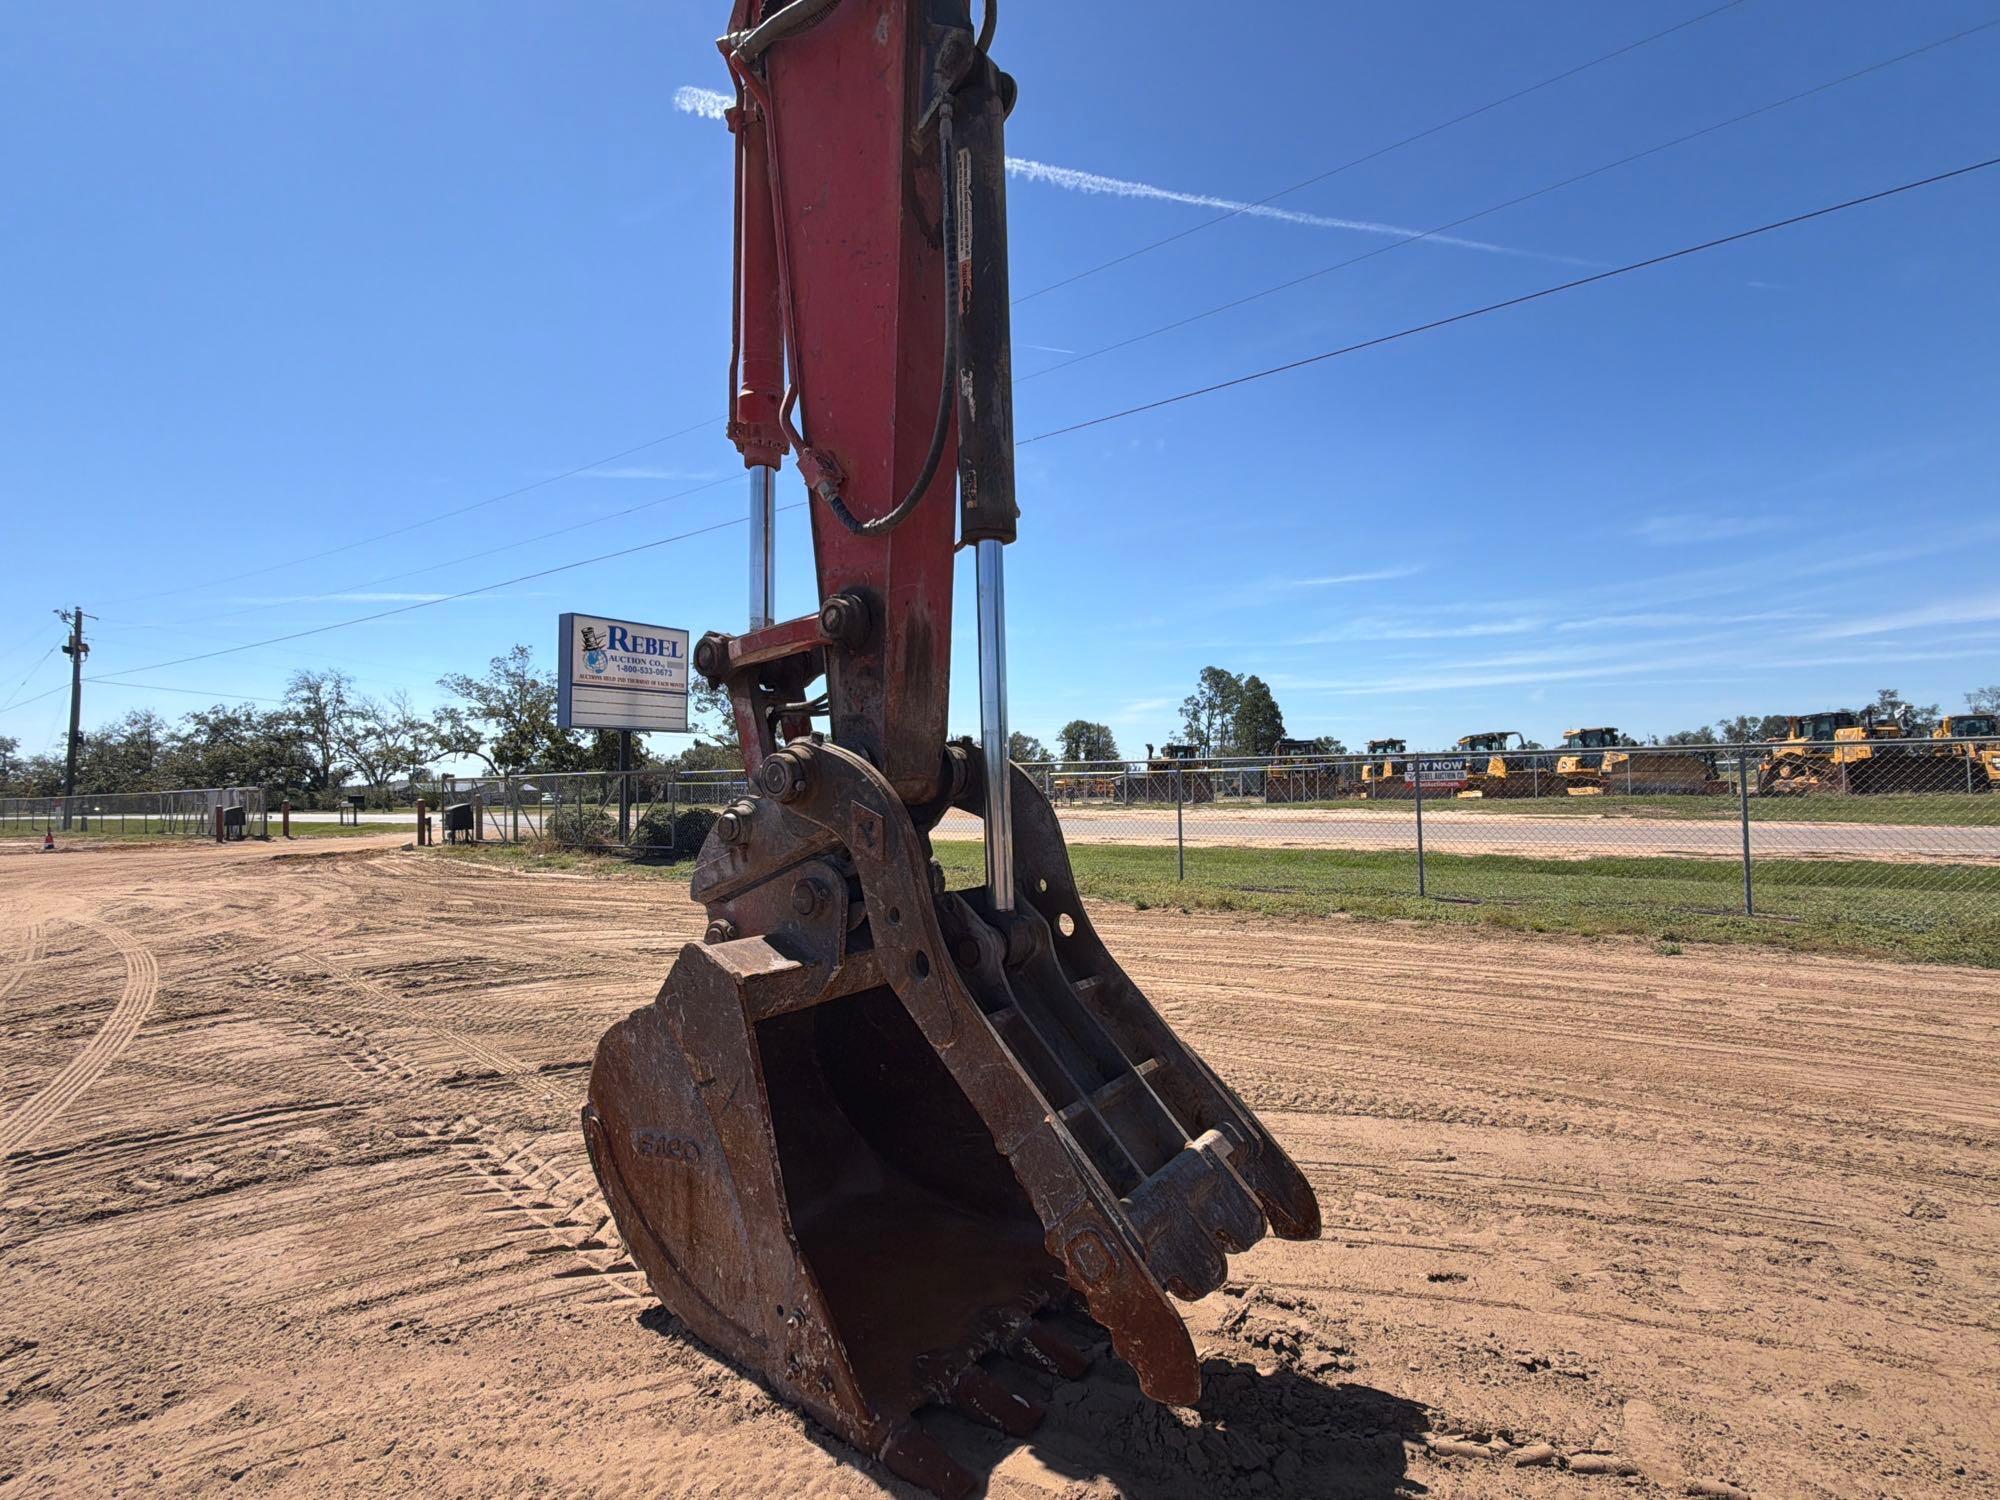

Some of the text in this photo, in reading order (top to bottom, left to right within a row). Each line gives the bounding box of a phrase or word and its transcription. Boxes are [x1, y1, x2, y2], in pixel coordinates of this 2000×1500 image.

[607, 625, 684, 659] REBEL
[608, 655, 647, 665] AUCTION
[1432, 761, 1463, 771] NOW
